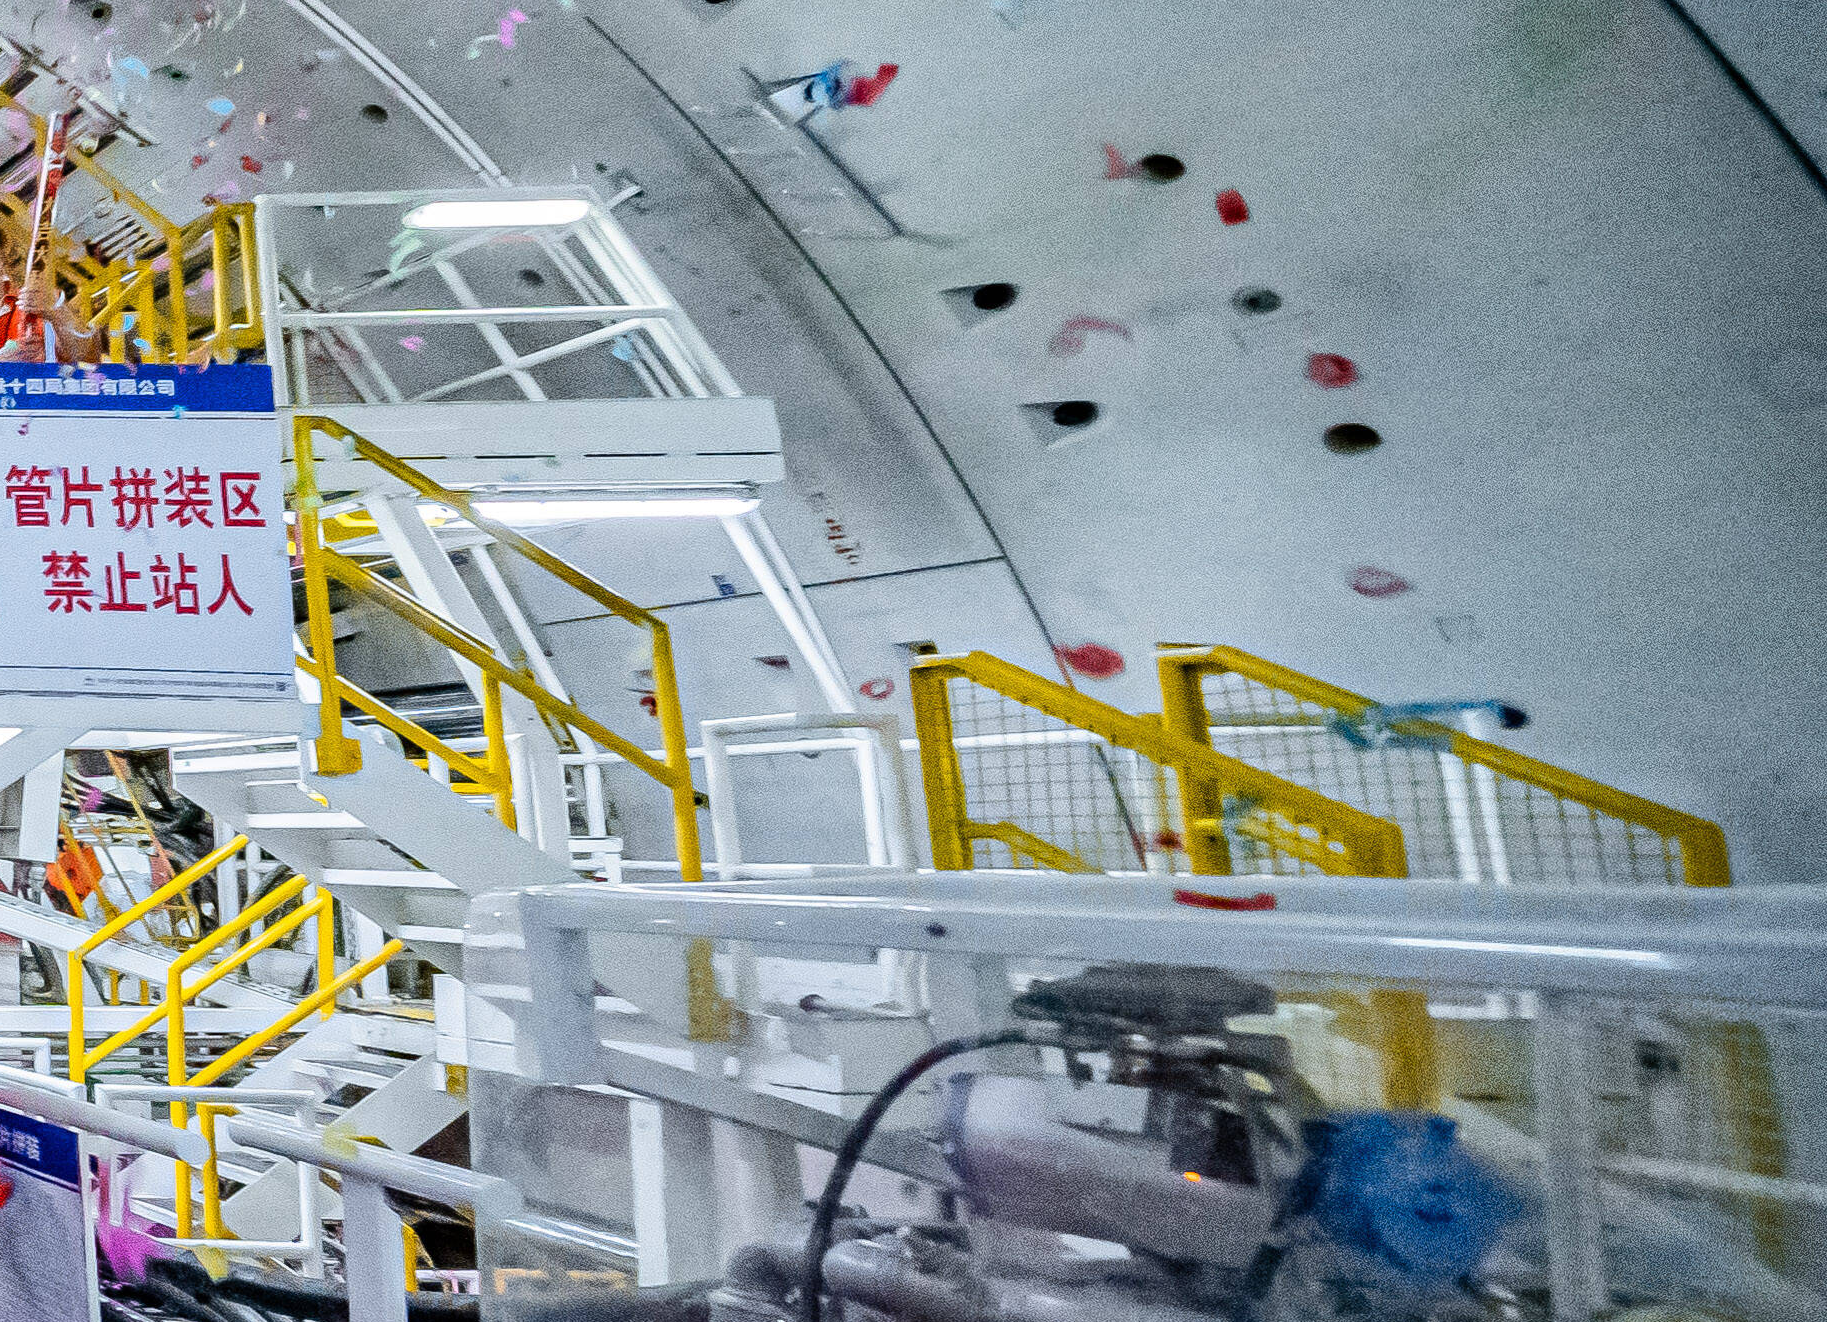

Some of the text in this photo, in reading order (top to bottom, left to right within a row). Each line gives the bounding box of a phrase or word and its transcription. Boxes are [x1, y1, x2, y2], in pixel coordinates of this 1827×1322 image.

[5, 465, 266, 528] 管片拼装区
[42, 550, 254, 615] 禁止站人
